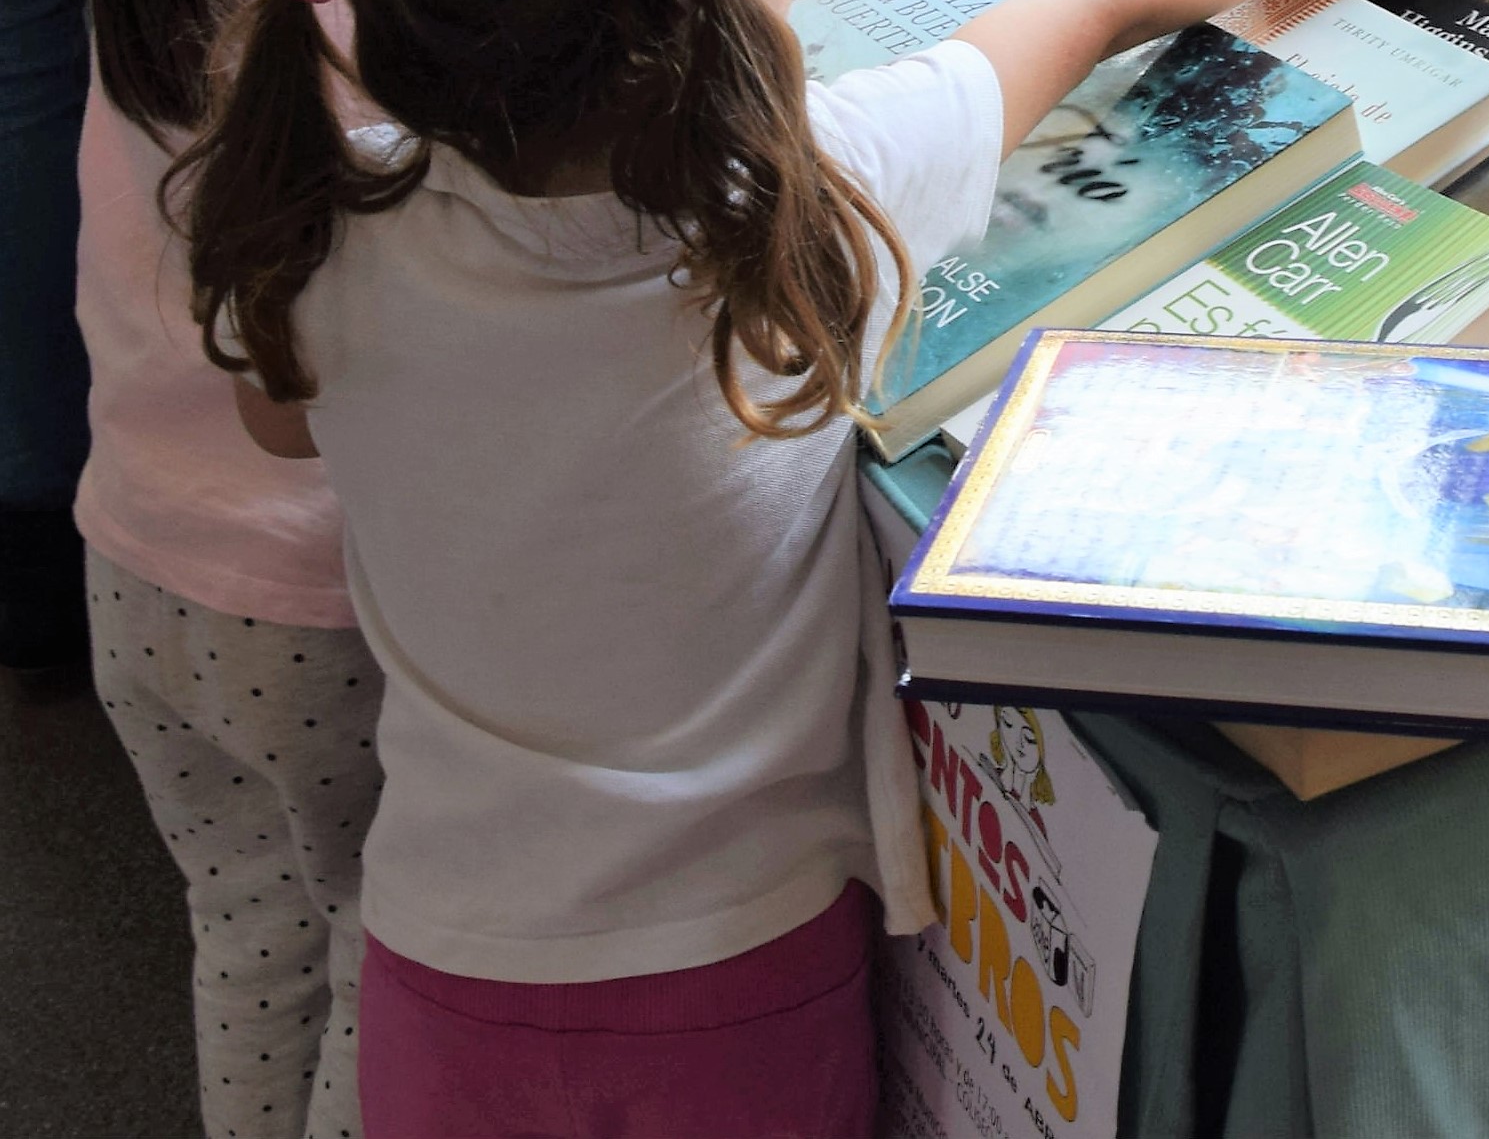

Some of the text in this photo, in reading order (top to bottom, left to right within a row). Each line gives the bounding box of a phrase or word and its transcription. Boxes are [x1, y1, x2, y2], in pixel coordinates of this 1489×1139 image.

[902, 0, 963, 42] BUE
[1333, 17, 1465, 90] THRITY UMRIGAR
[1361, 100, 1394, 126] de
[1246, 239, 1343, 305] Carr
[1280, 210, 1390, 282] Allen
[934, 255, 1001, 303] ALSE
[1163, 279, 1235, 336] Es
[975, 1016, 997, 1065] 24
